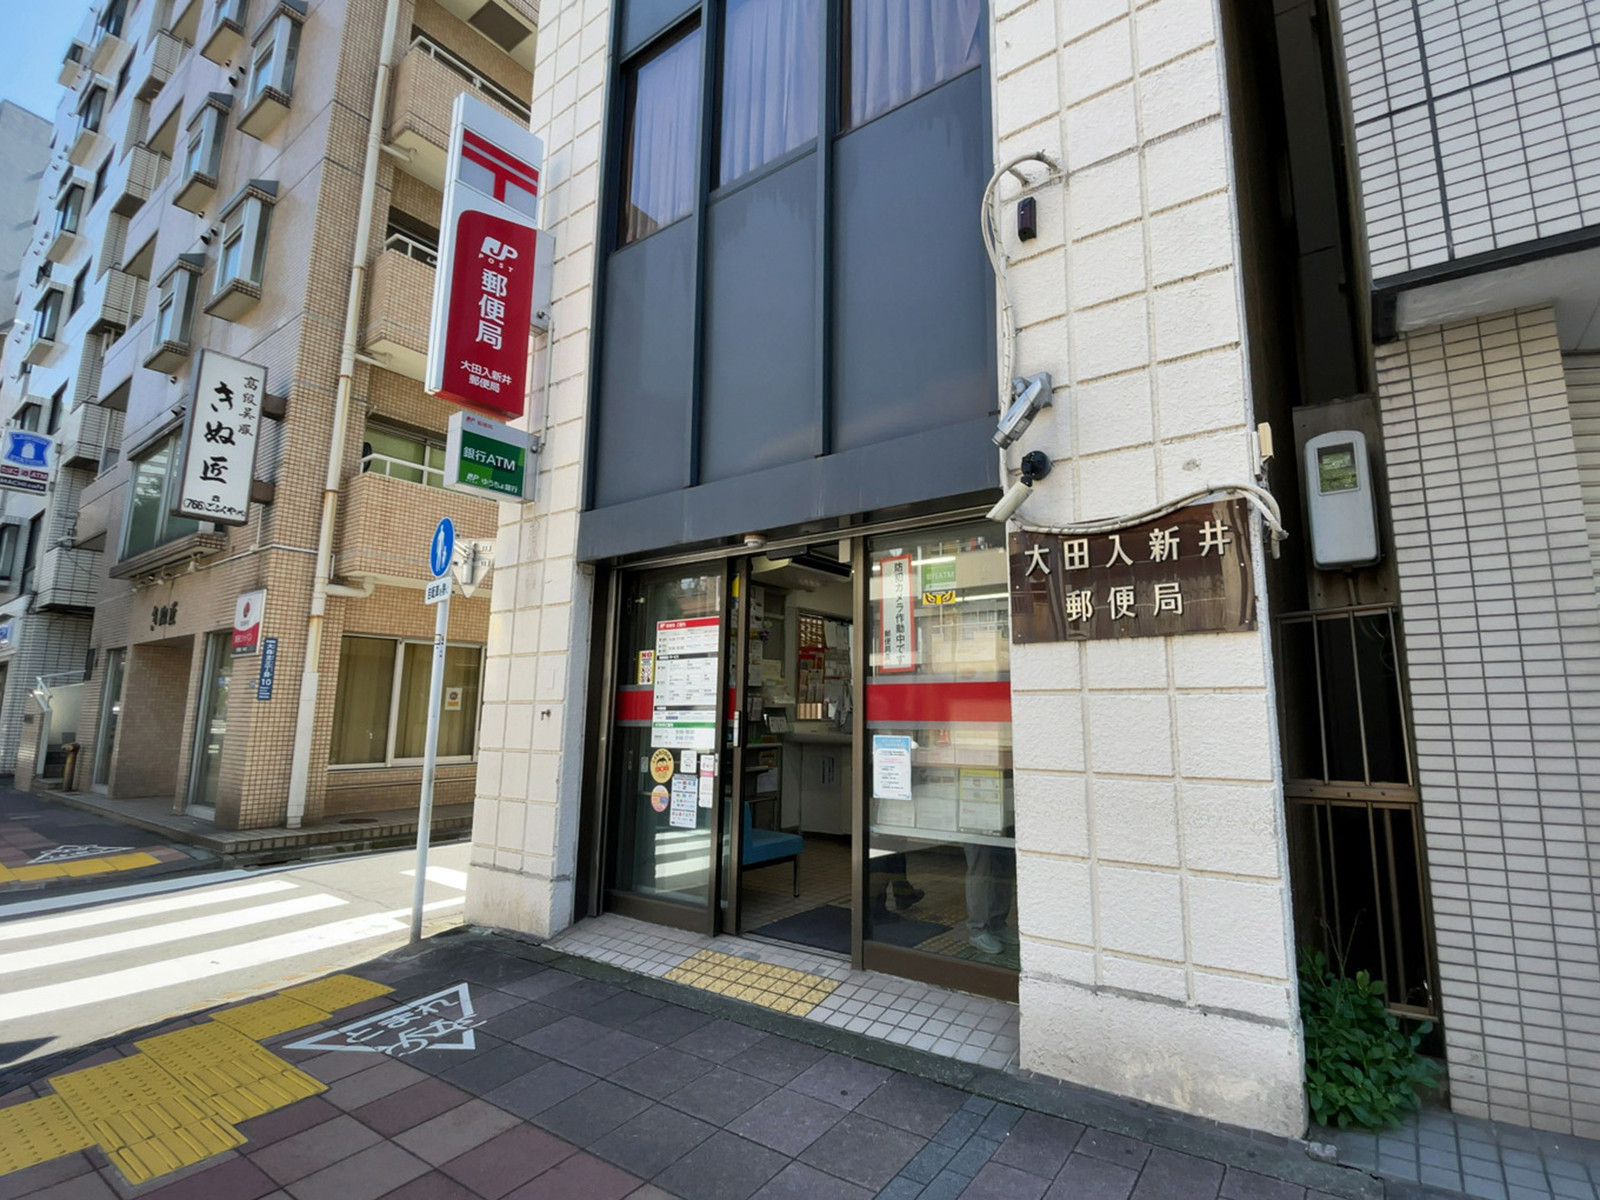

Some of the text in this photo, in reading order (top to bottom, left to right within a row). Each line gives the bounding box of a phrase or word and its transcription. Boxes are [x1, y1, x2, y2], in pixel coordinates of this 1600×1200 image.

[478, 254, 514, 273] POST
[476, 268, 508, 350] 郵便局
[460, 360, 513, 386] 大田入新井
[468, 374, 500, 393] 郵便局
[463, 446, 516, 471] 銀行ATM
[481, 477, 518, 493] ゆうちょ銀行
[1024, 519, 1231, 576] 大田入新井
[1065, 582, 1183, 622] 郵便局
